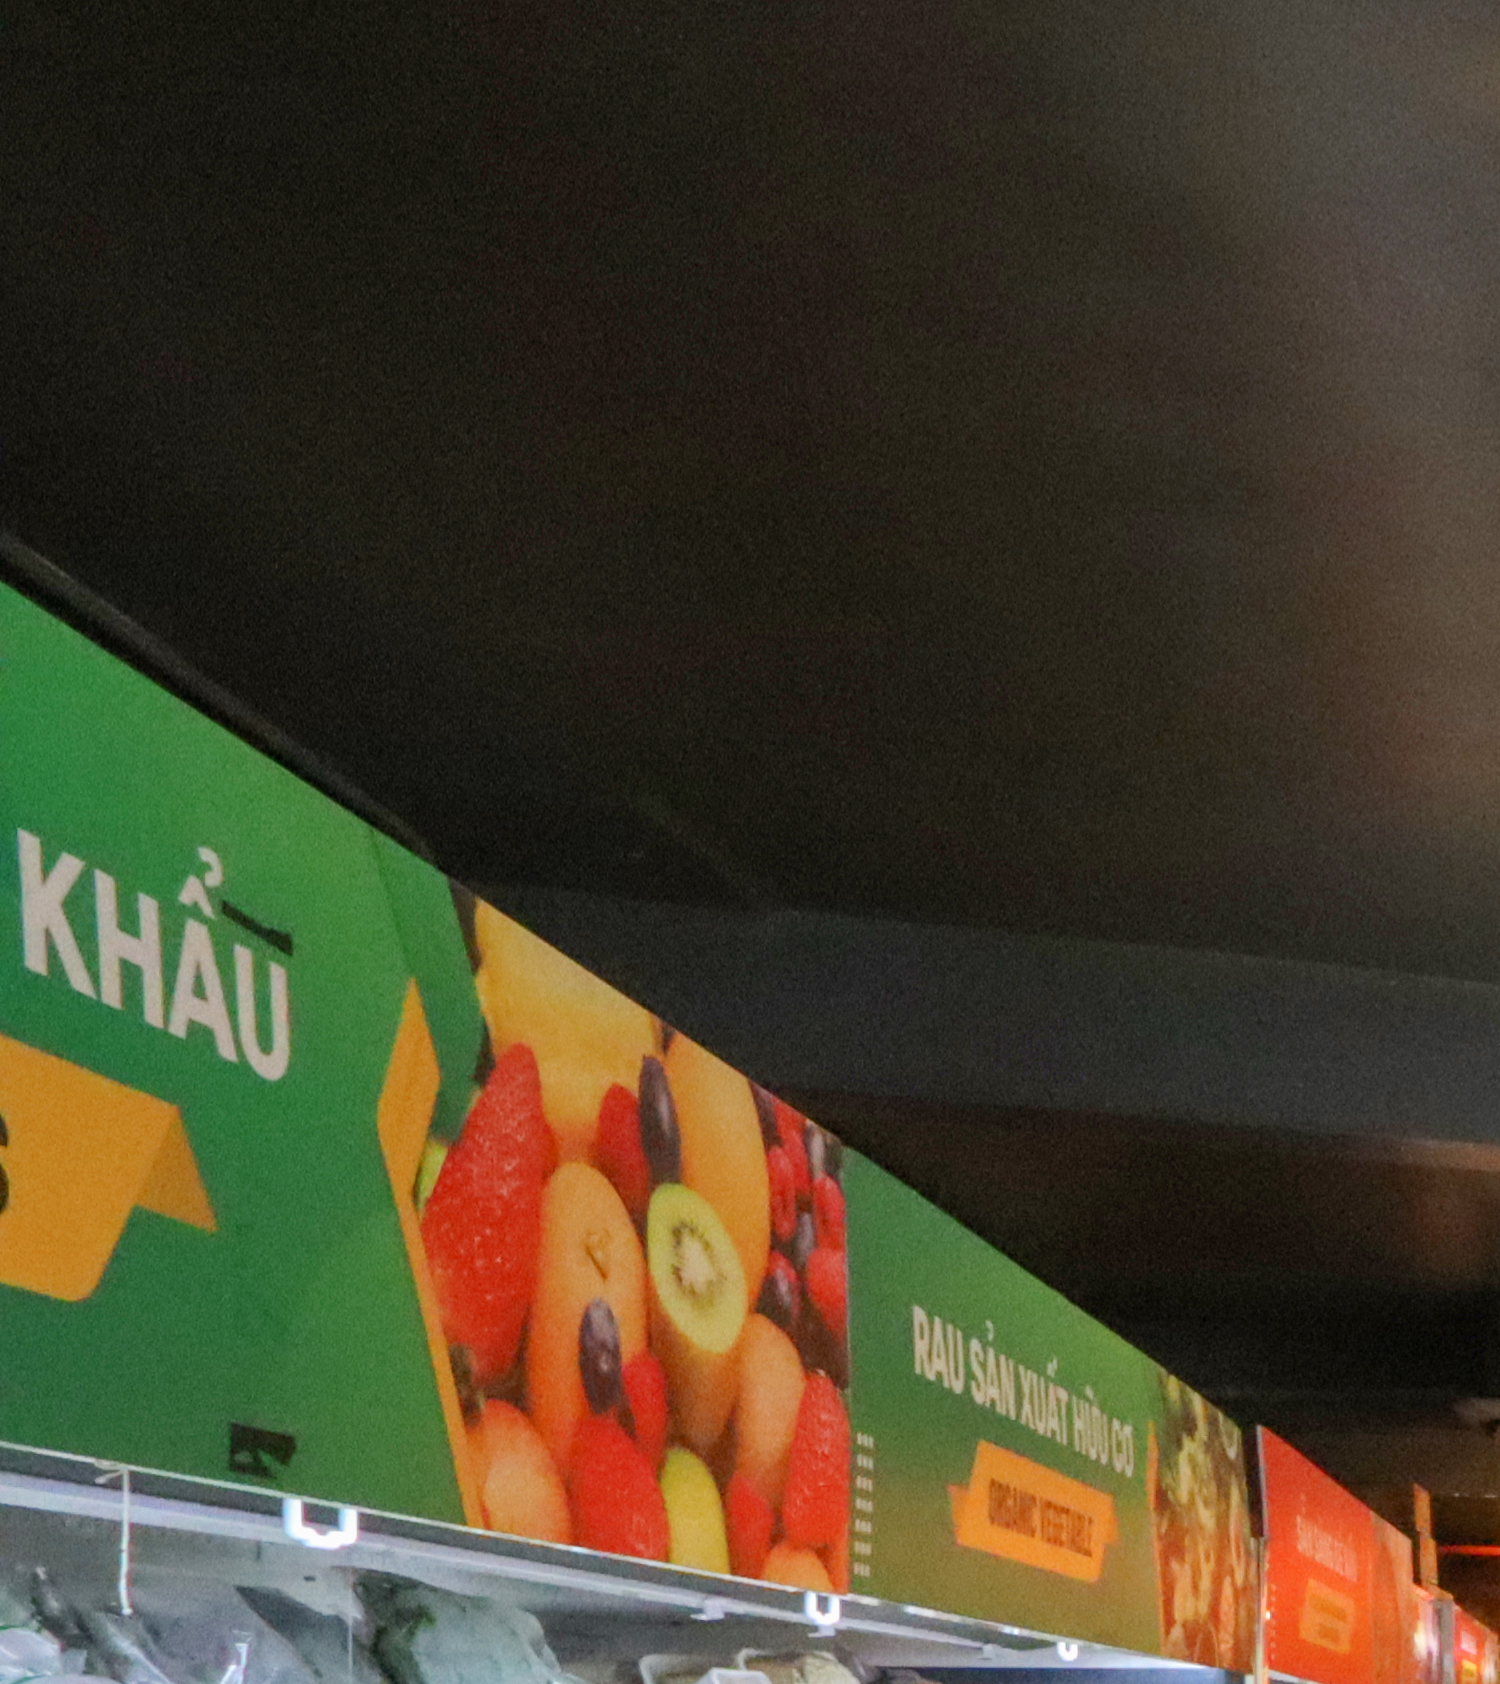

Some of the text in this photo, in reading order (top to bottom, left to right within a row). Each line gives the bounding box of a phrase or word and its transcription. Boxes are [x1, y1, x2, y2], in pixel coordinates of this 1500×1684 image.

[17, 828, 289, 1082] KHẨU
[913, 1305, 1068, 1446] RAU SẢN XUẤT
